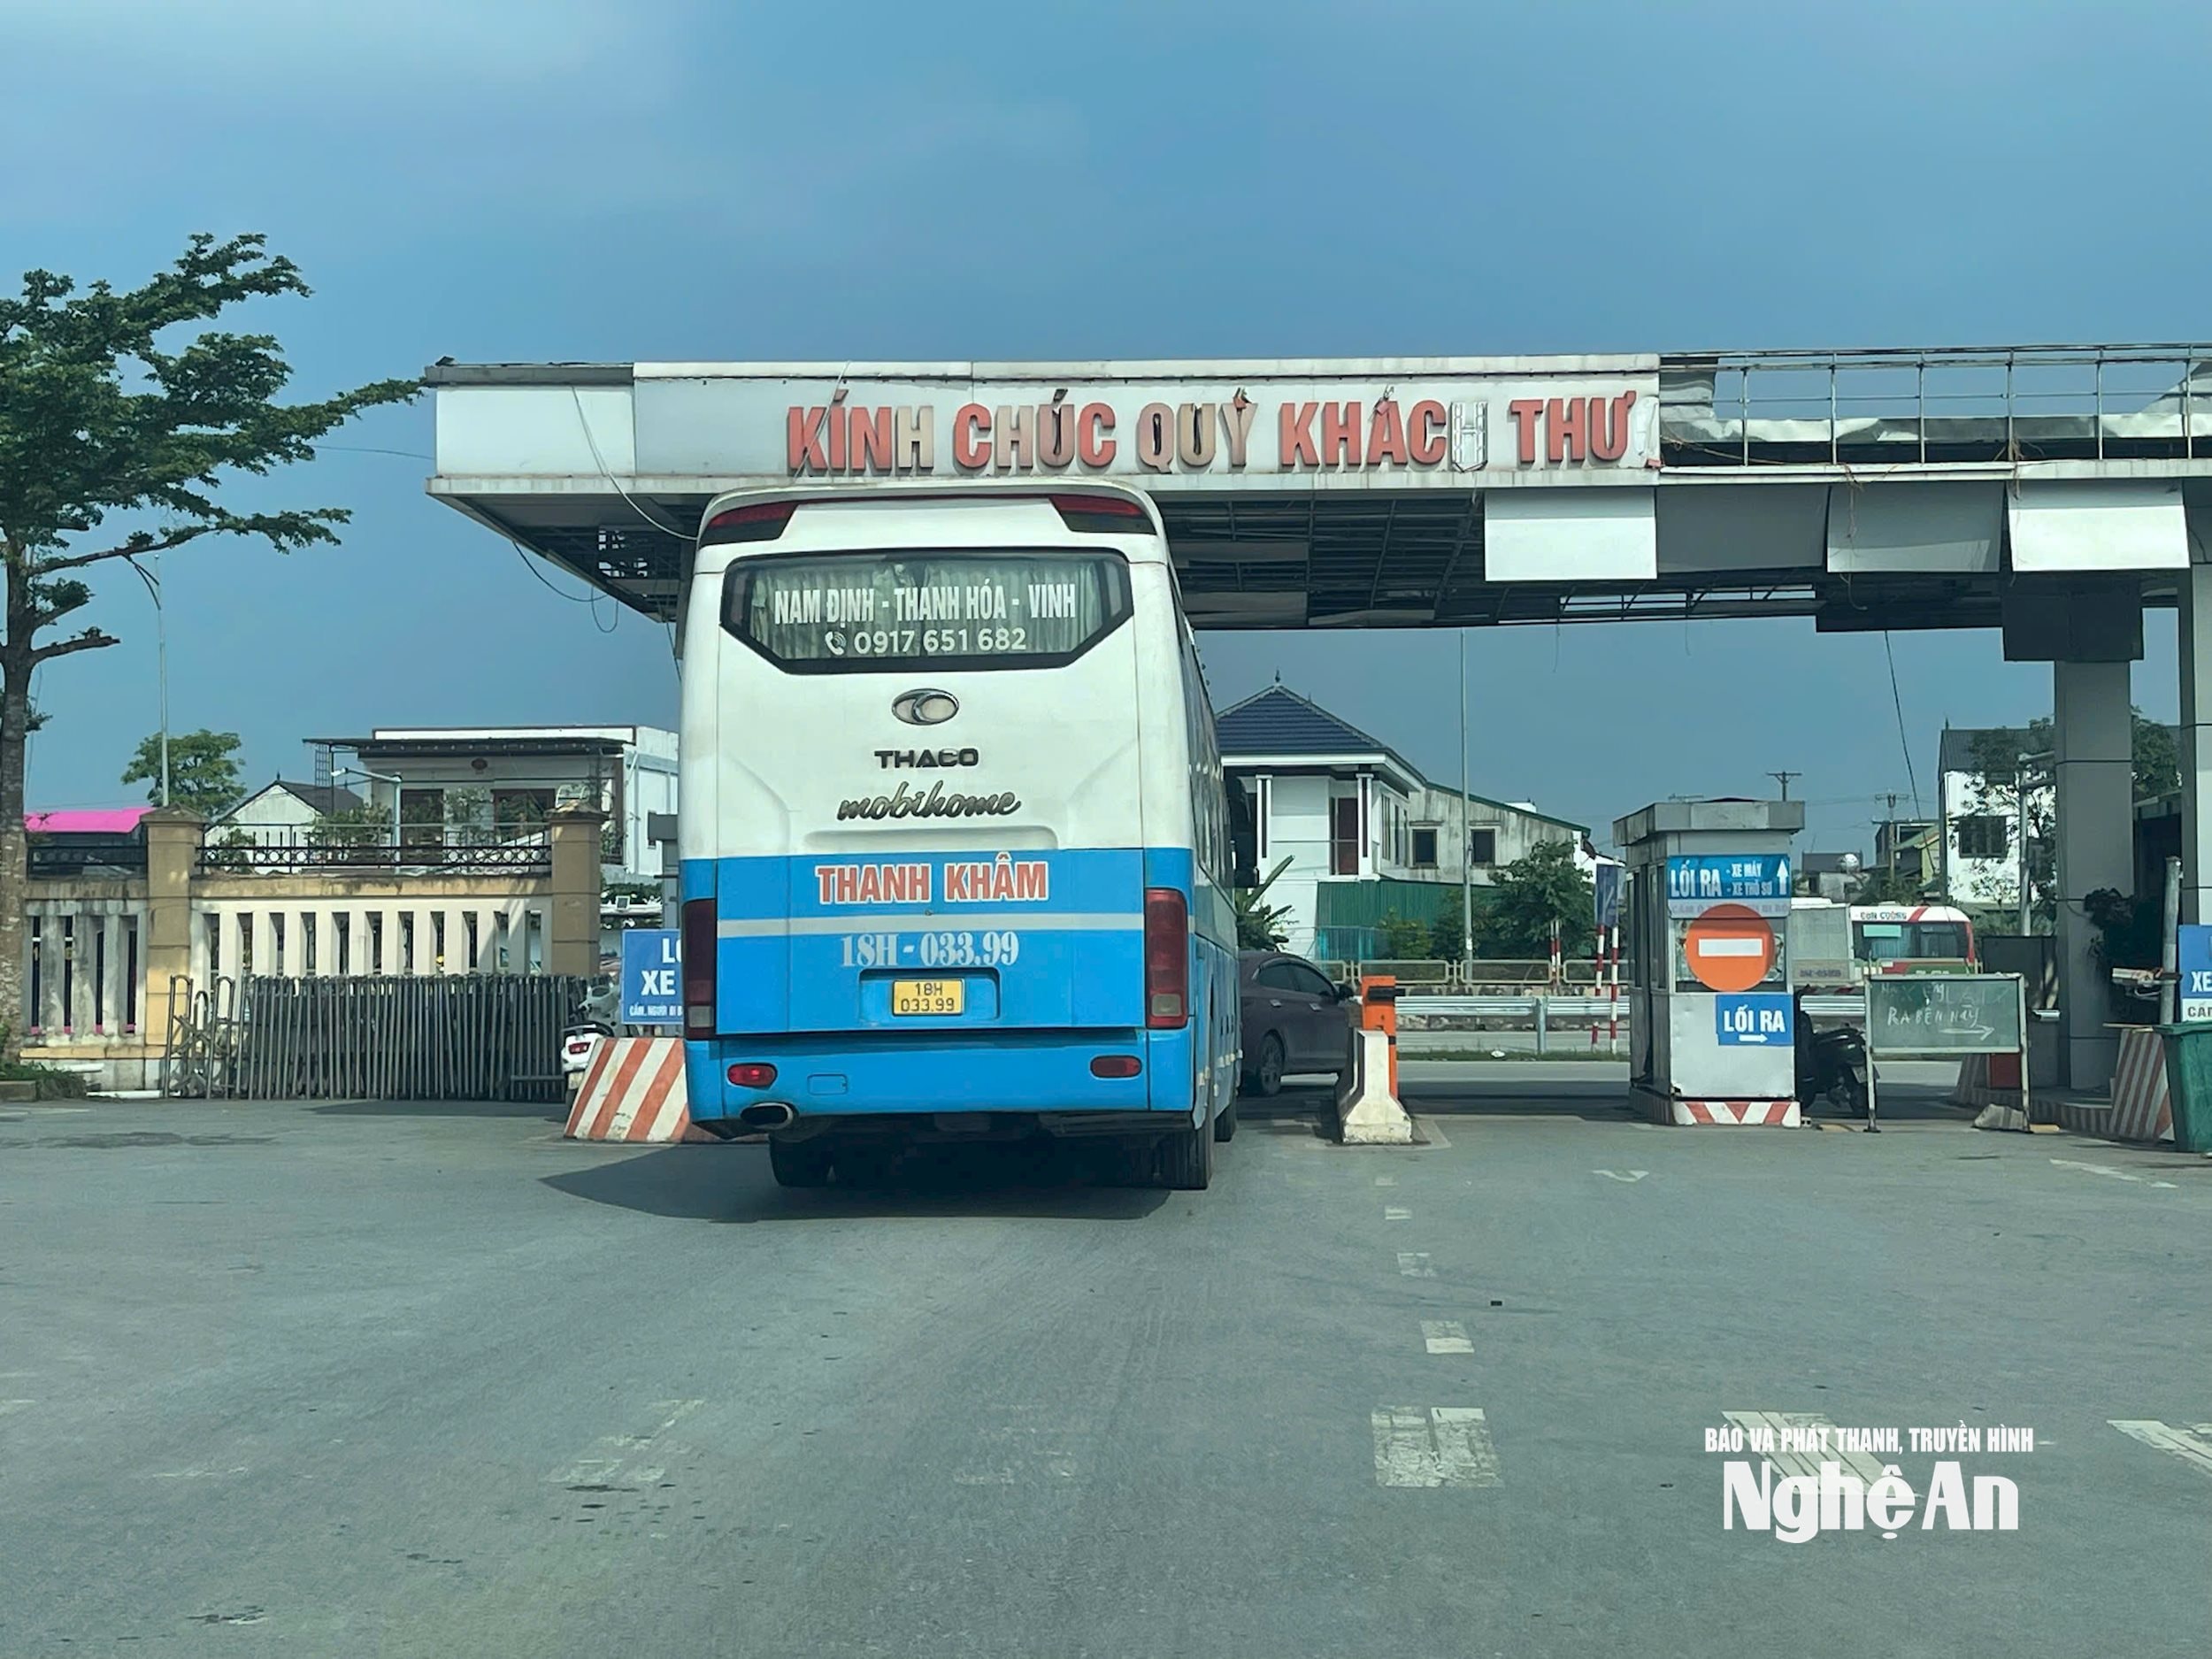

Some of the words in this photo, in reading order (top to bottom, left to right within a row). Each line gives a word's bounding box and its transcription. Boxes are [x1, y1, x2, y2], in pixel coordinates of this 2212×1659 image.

[787, 388, 934, 471] KÍNH
[954, 388, 1117, 471] CHÚC
[774, 589, 821, 625] NAM
[826, 588, 875, 628] ĐỊNH
[894, 585, 959, 622] THANH
[966, 578, 1007, 620] HÓA
[1029, 583, 1076, 618] VINH
[854, 631, 914, 653] 0917
[923, 631, 968, 651] 651
[977, 627, 1026, 650] 682
[875, 748, 979, 769] THACO
[836, 781, 1021, 821] mobihome
[815, 863, 932, 904] THANH
[944, 851, 1048, 902] KHÂM
[1700, 868, 1722, 896] RA
[641, 970, 676, 996] XE
[915, 982, 943, 996] 18H
[2191, 971, 2212, 992] XE
[900, 998, 955, 1012] 033.99
[1760, 1010, 1786, 1033] RA
